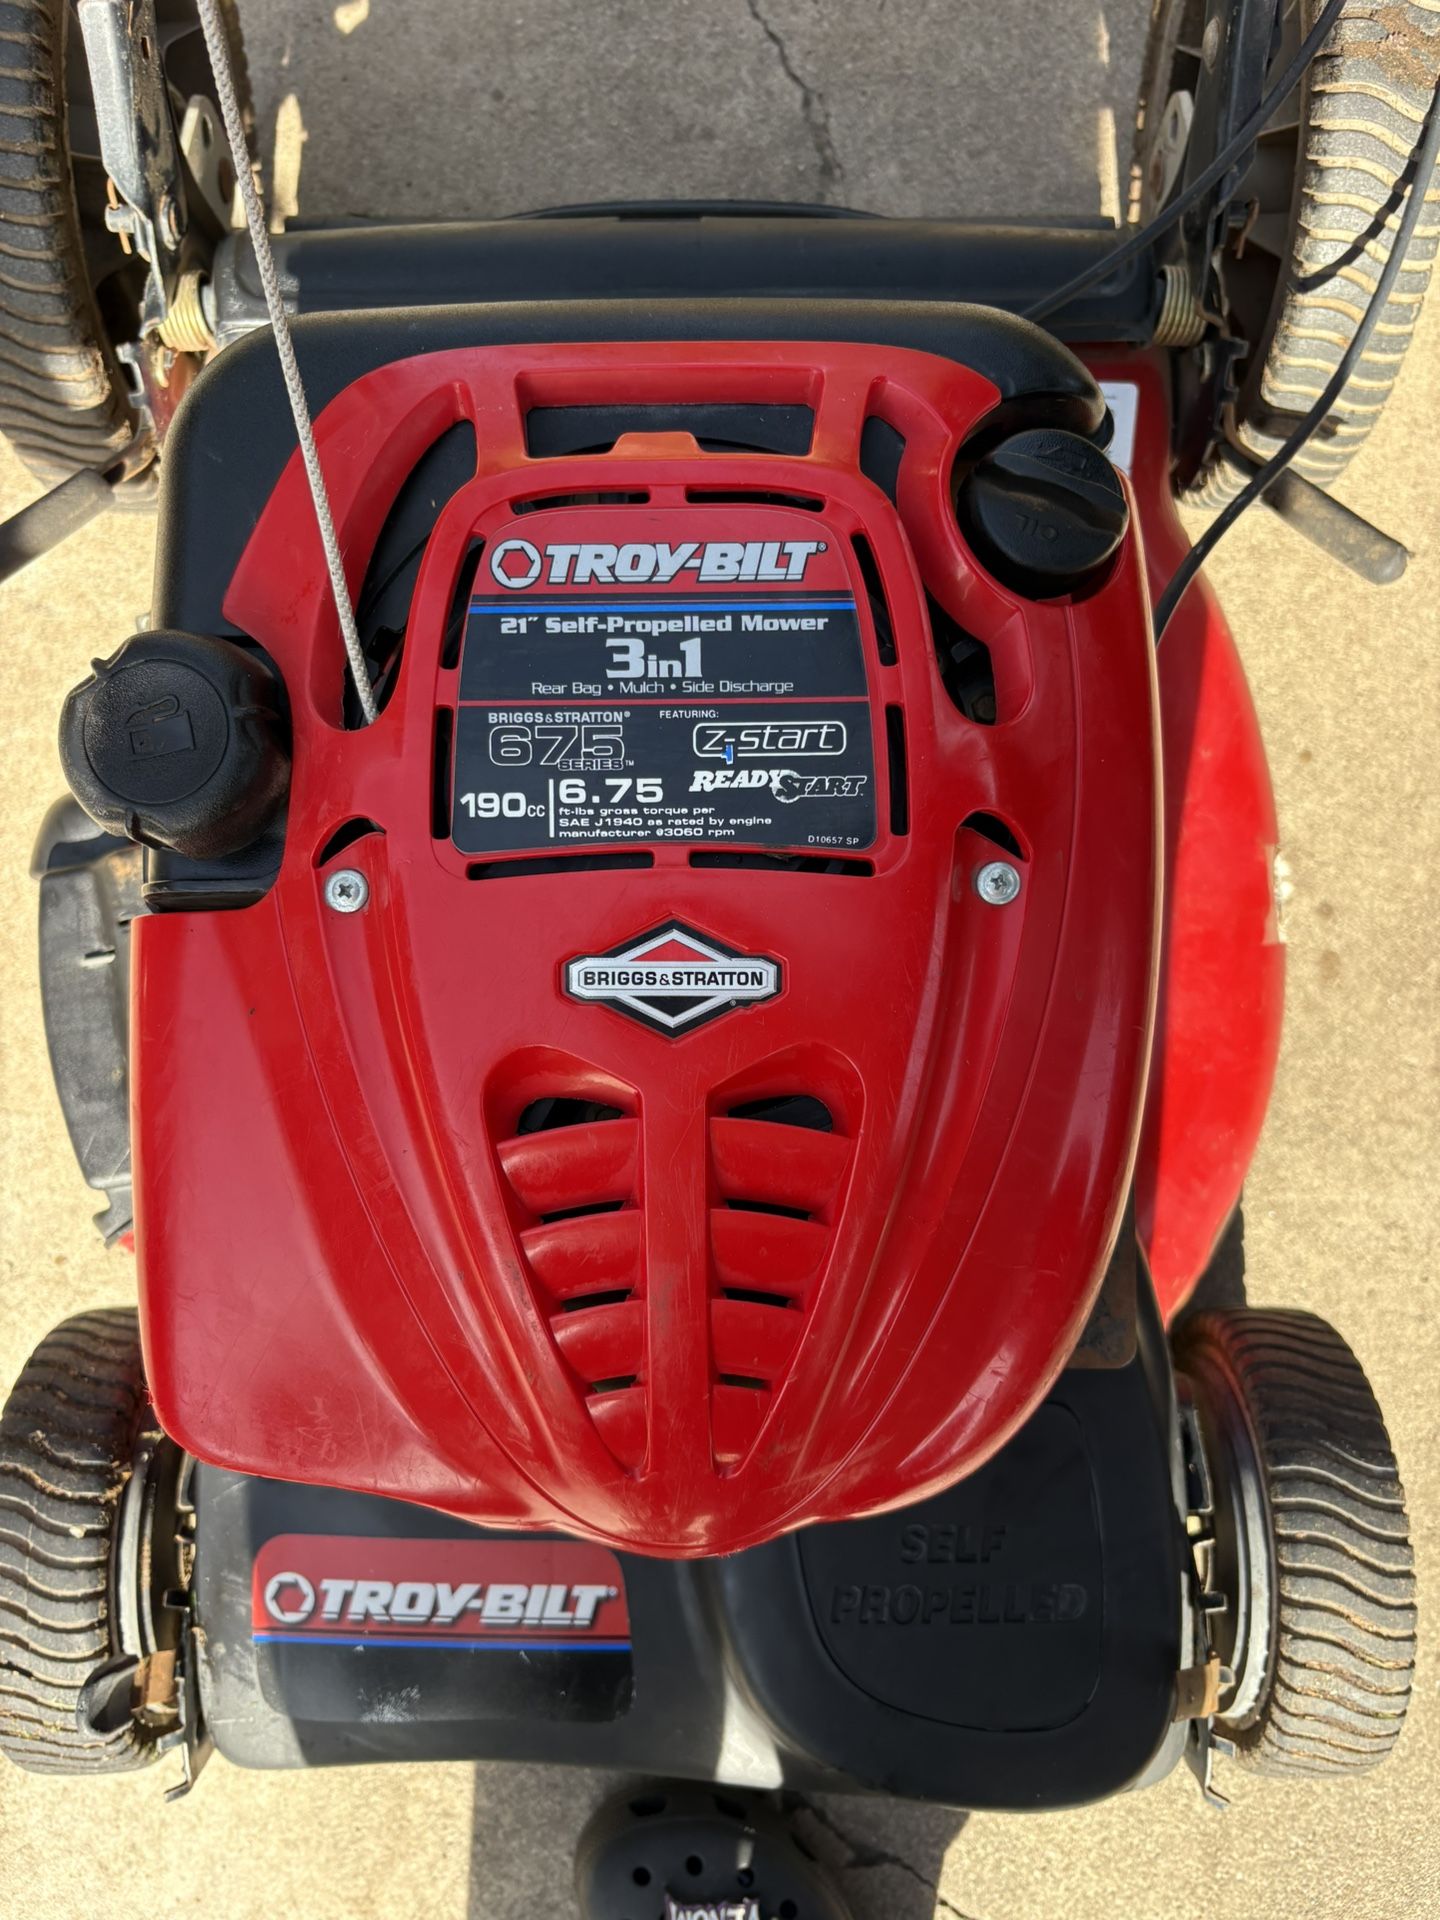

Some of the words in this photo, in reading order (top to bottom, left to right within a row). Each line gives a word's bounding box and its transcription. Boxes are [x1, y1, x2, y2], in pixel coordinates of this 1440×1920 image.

[545, 615, 732, 636] Self-Propelled
[741, 614, 829, 631] Mower
[531, 682, 567, 695] Rear
[572, 682, 602, 697] Bag
[619, 681, 664, 694] Mulch
[682, 680, 714, 693] Side
[719, 680, 794, 694] Discharge
[659, 710, 719, 719] FEATURING:
[489, 724, 625, 766] 675
[558, 777, 664, 804] 6.75
[559, 806, 595, 816] ft-lbs
[600, 807, 639, 817] gross
[643, 806, 688, 816] torque
[693, 807, 715, 816] per
[559, 818, 590, 827] SAE
[594, 818, 643, 827] J1940
[667, 817, 704, 826] rated
[709, 816, 724, 828] by
[729, 816, 772, 827] engine
[559, 829, 651, 838] manufacturer
[708, 828, 735, 838] rpm
[807, 835, 843, 845] D10657
[846, 836, 860, 845] SP
[583, 970, 764, 986] BRIGGS&STRATTON
[901, 1522, 1007, 1565] SELF
[830, 1583, 1088, 1625] PROPELLED
